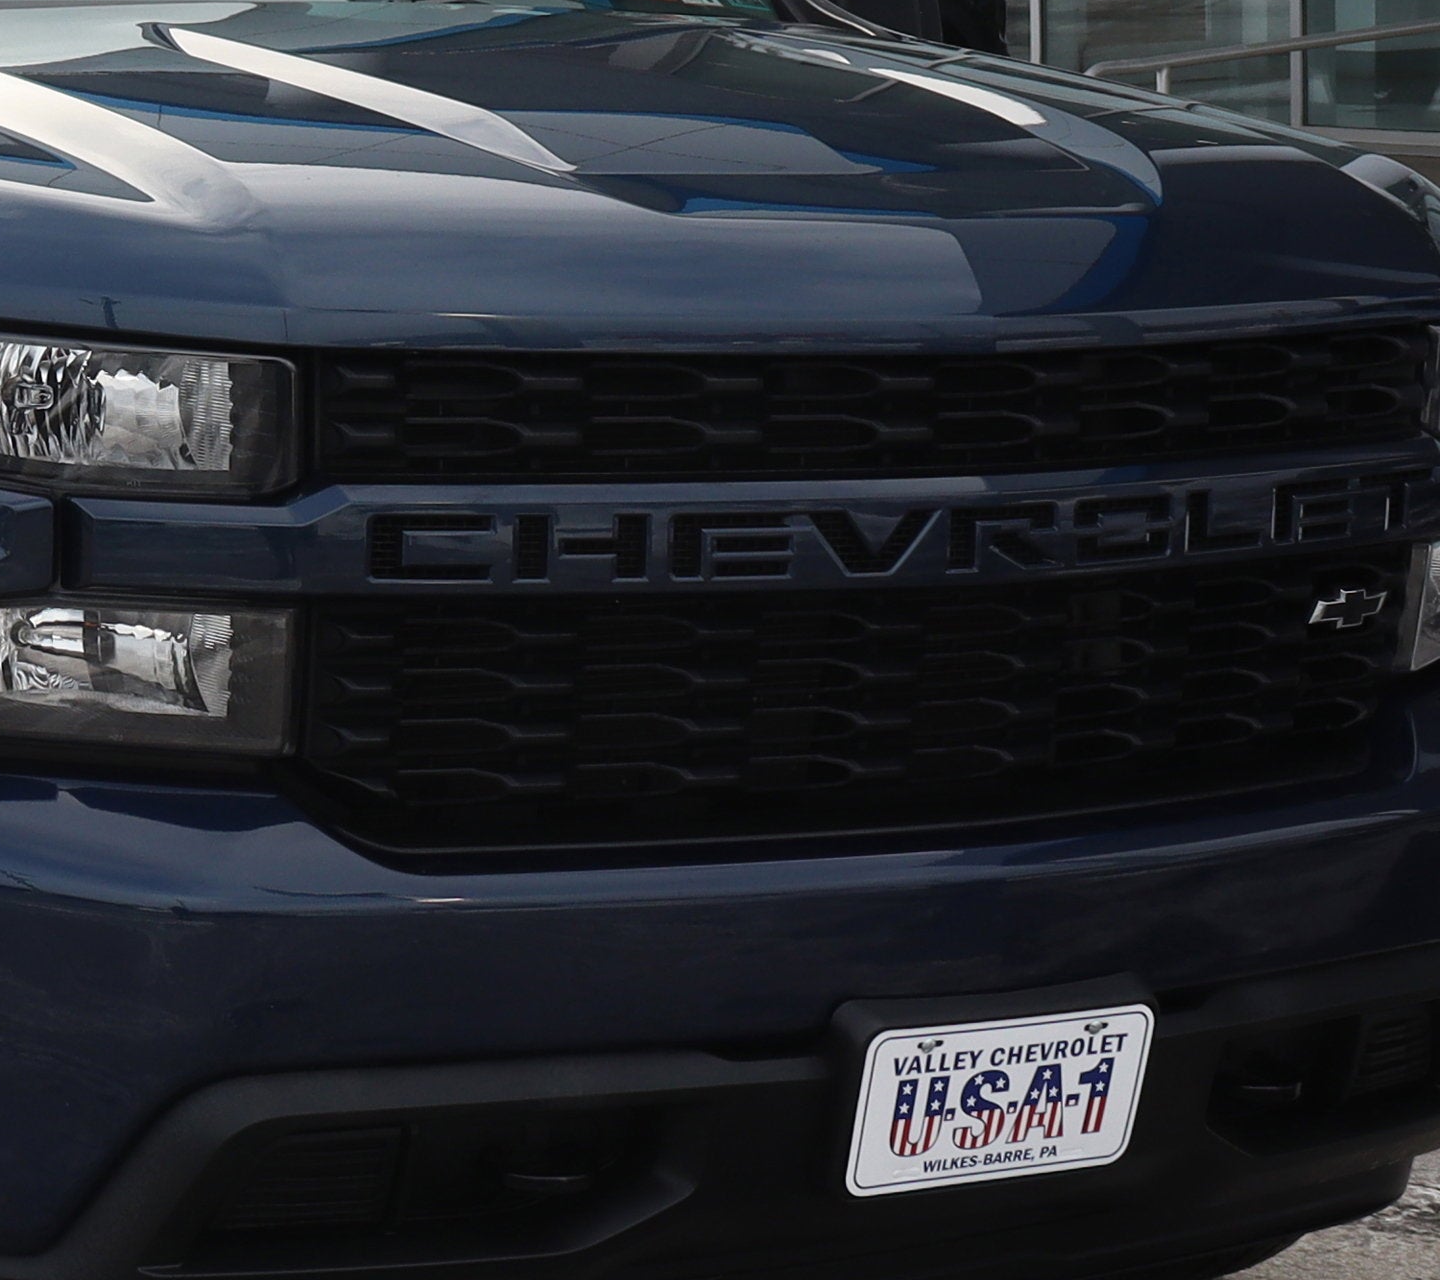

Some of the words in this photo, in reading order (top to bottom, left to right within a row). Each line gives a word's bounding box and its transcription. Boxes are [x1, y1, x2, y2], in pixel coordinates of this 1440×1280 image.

[365, 467, 1436, 584] CHEVROLET
[894, 1049, 983, 1076] VALLEY
[990, 1032, 1128, 1067] CHEVROLET
[923, 1147, 1035, 1173] WILKES-BARRE,
[1040, 1145, 1058, 1159] PA
